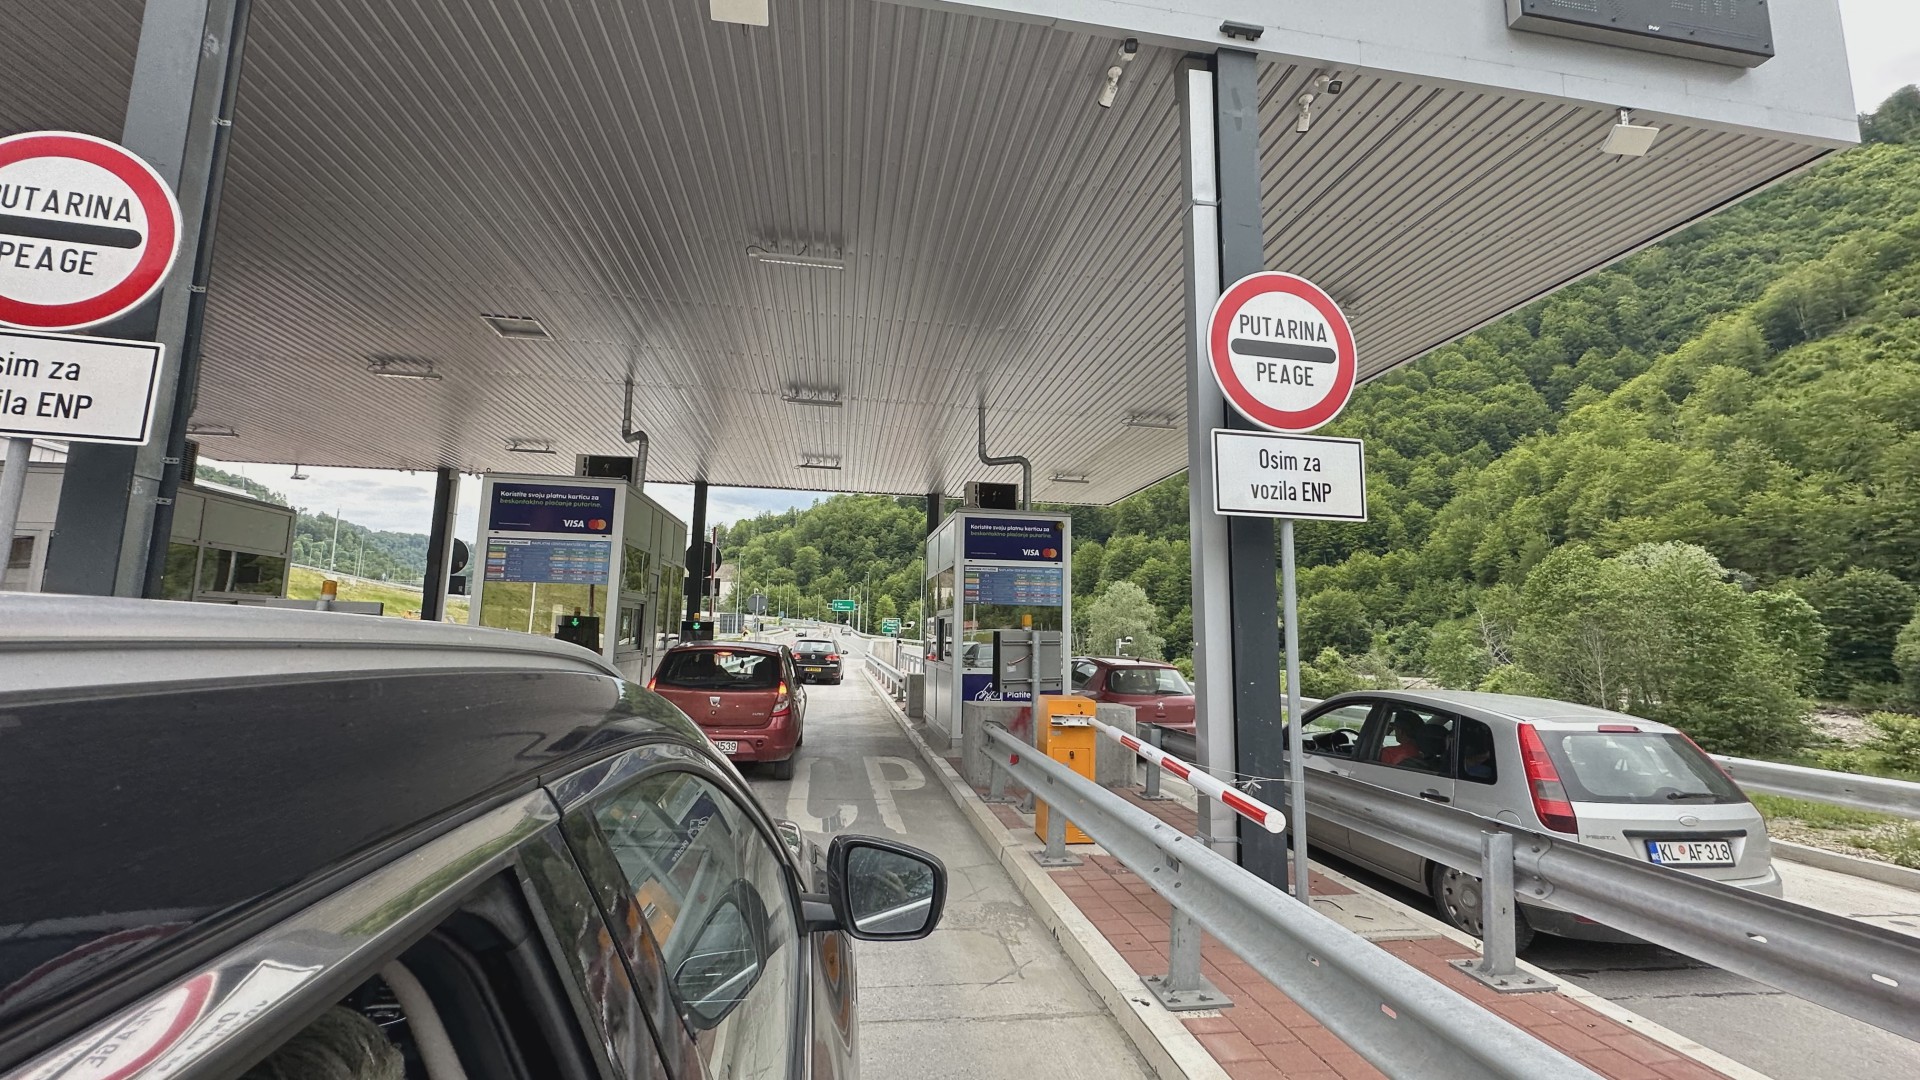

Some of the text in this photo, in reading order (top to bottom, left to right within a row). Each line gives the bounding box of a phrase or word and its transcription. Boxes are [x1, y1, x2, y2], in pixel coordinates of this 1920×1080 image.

[0, 183, 131, 222] UTARINA
[0, 241, 98, 276] PEAGE
[1239, 314, 1327, 343] PUTARINA
[48, 361, 81, 382] za
[1256, 362, 1315, 387] PEAGE
[36, 392, 93, 419] ENP
[1259, 448, 1321, 473] Osim za
[500, 490, 527, 498] Koristite
[528, 491, 545, 499] svoju
[546, 492, 567, 500] platnu
[568, 493, 590, 501] karticu
[1251, 480, 1332, 503] vozila ENP
[563, 519, 585, 528] VISA
[1022, 548, 1039, 556] VISA
[1006, 691, 1032, 699] Platite
[1659, 843, 1680, 861] KL
